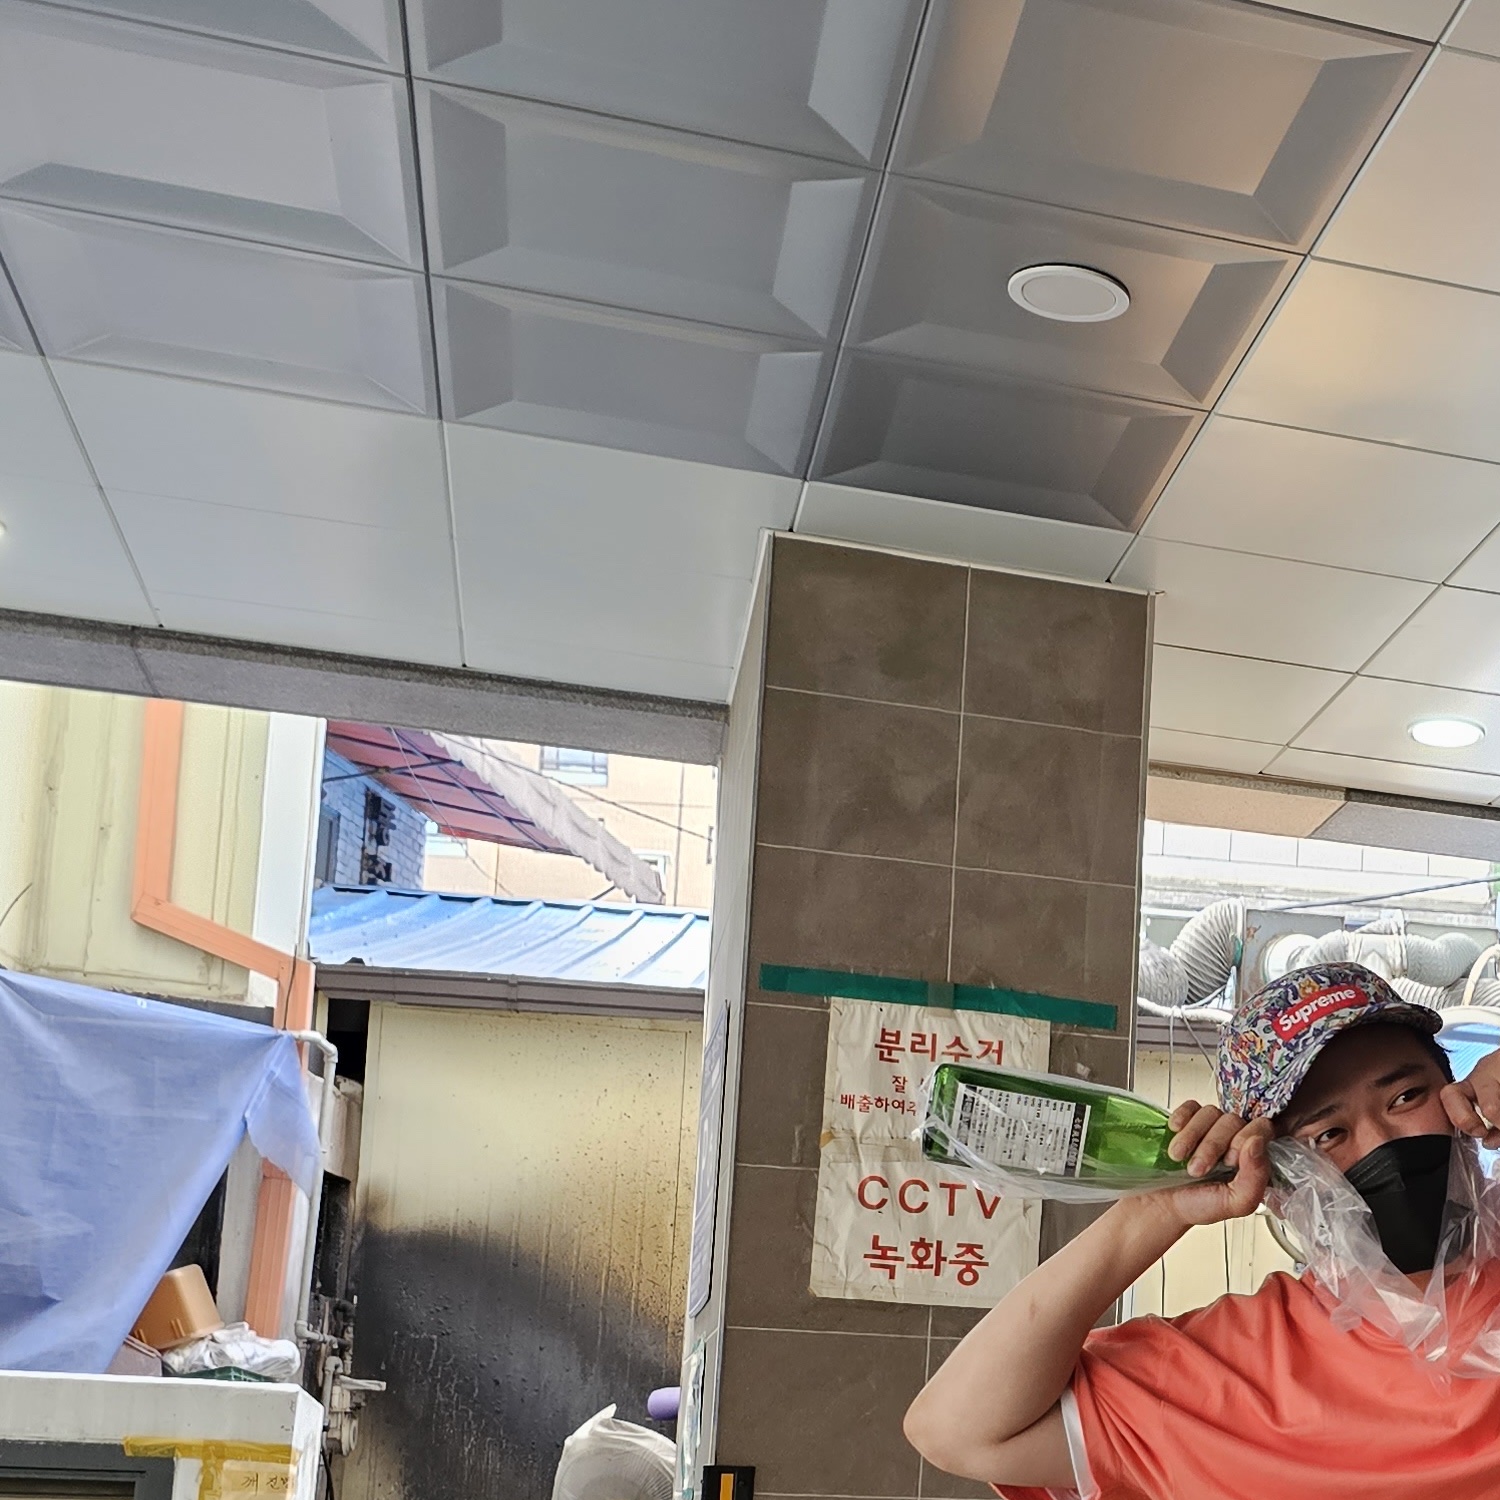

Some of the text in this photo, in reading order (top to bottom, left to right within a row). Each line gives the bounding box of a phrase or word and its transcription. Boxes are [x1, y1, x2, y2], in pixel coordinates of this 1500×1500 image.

[1279, 988, 1356, 1031] Supreme
[875, 1028, 1003, 1065] 분리수거
[892, 1076, 908, 1094] 잘
[857, 1176, 1001, 1220] CCTV
[863, 1235, 989, 1286] 녹화중
